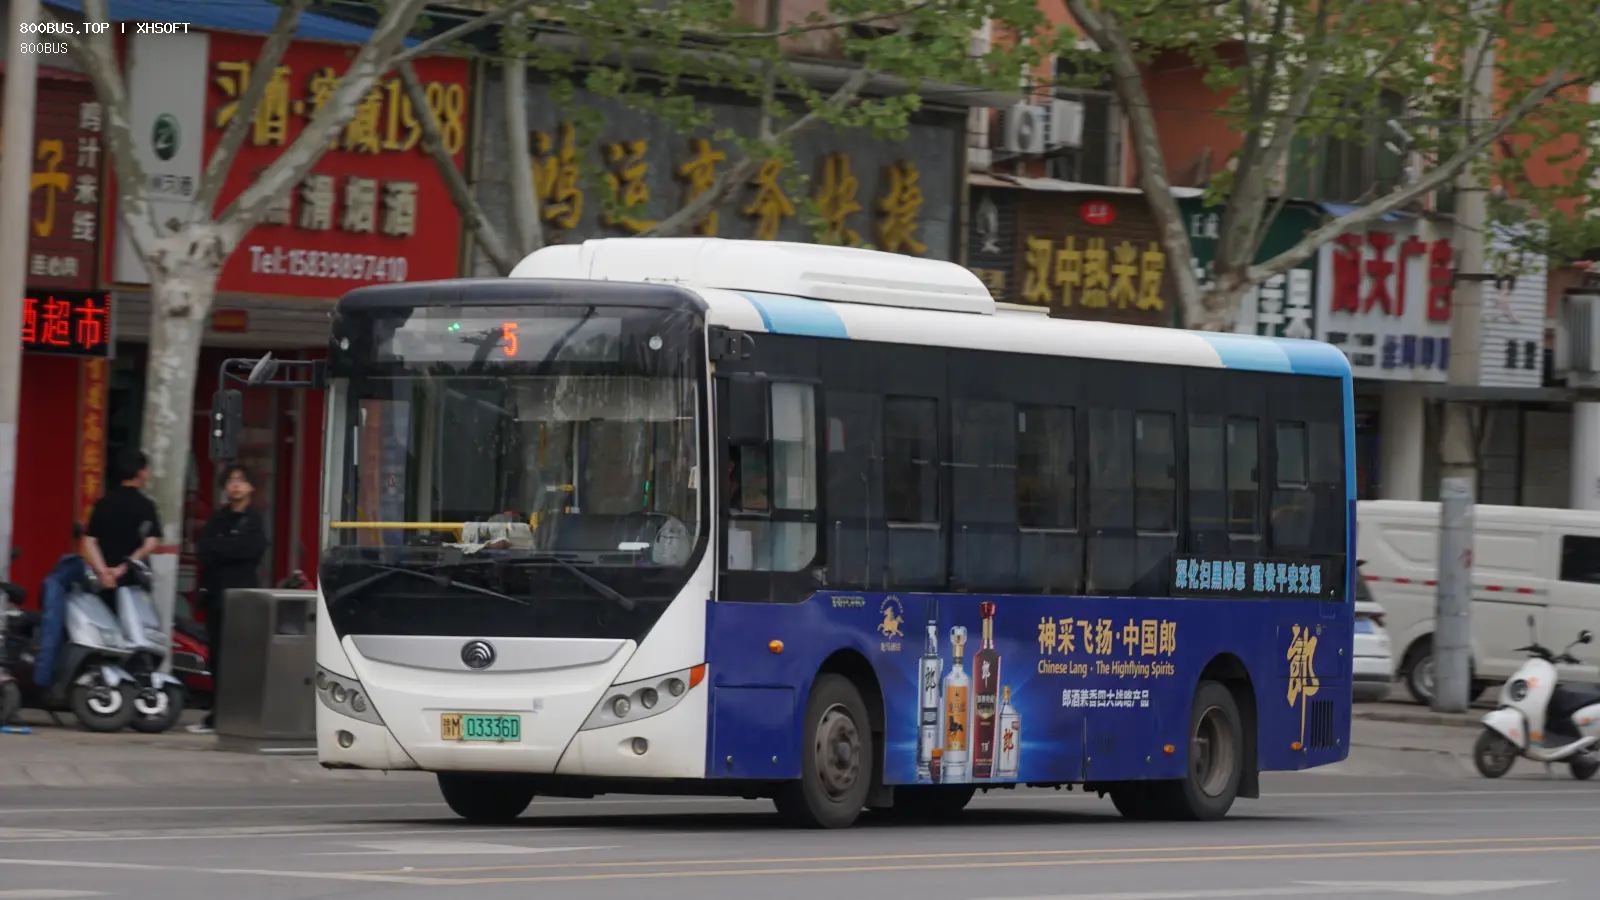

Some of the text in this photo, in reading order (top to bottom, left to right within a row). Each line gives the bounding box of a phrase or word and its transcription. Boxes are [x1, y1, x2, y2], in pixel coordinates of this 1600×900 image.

[1022, 234, 1165, 312] 汉中热米皮
[503, 322, 518, 356] 5
[1175, 558, 1321, 594] 深化扫黑除恶 建设平安交通
[1038, 616, 1177, 656] 神采飞扬·中国郎
[1038, 660, 1067, 674] Chinese
[1070, 661, 1087, 678] Lang
[1096, 661, 1110, 675] The
[1111, 661, 1150, 678] Highflying
[1151, 661, 1175, 679] Spirits
